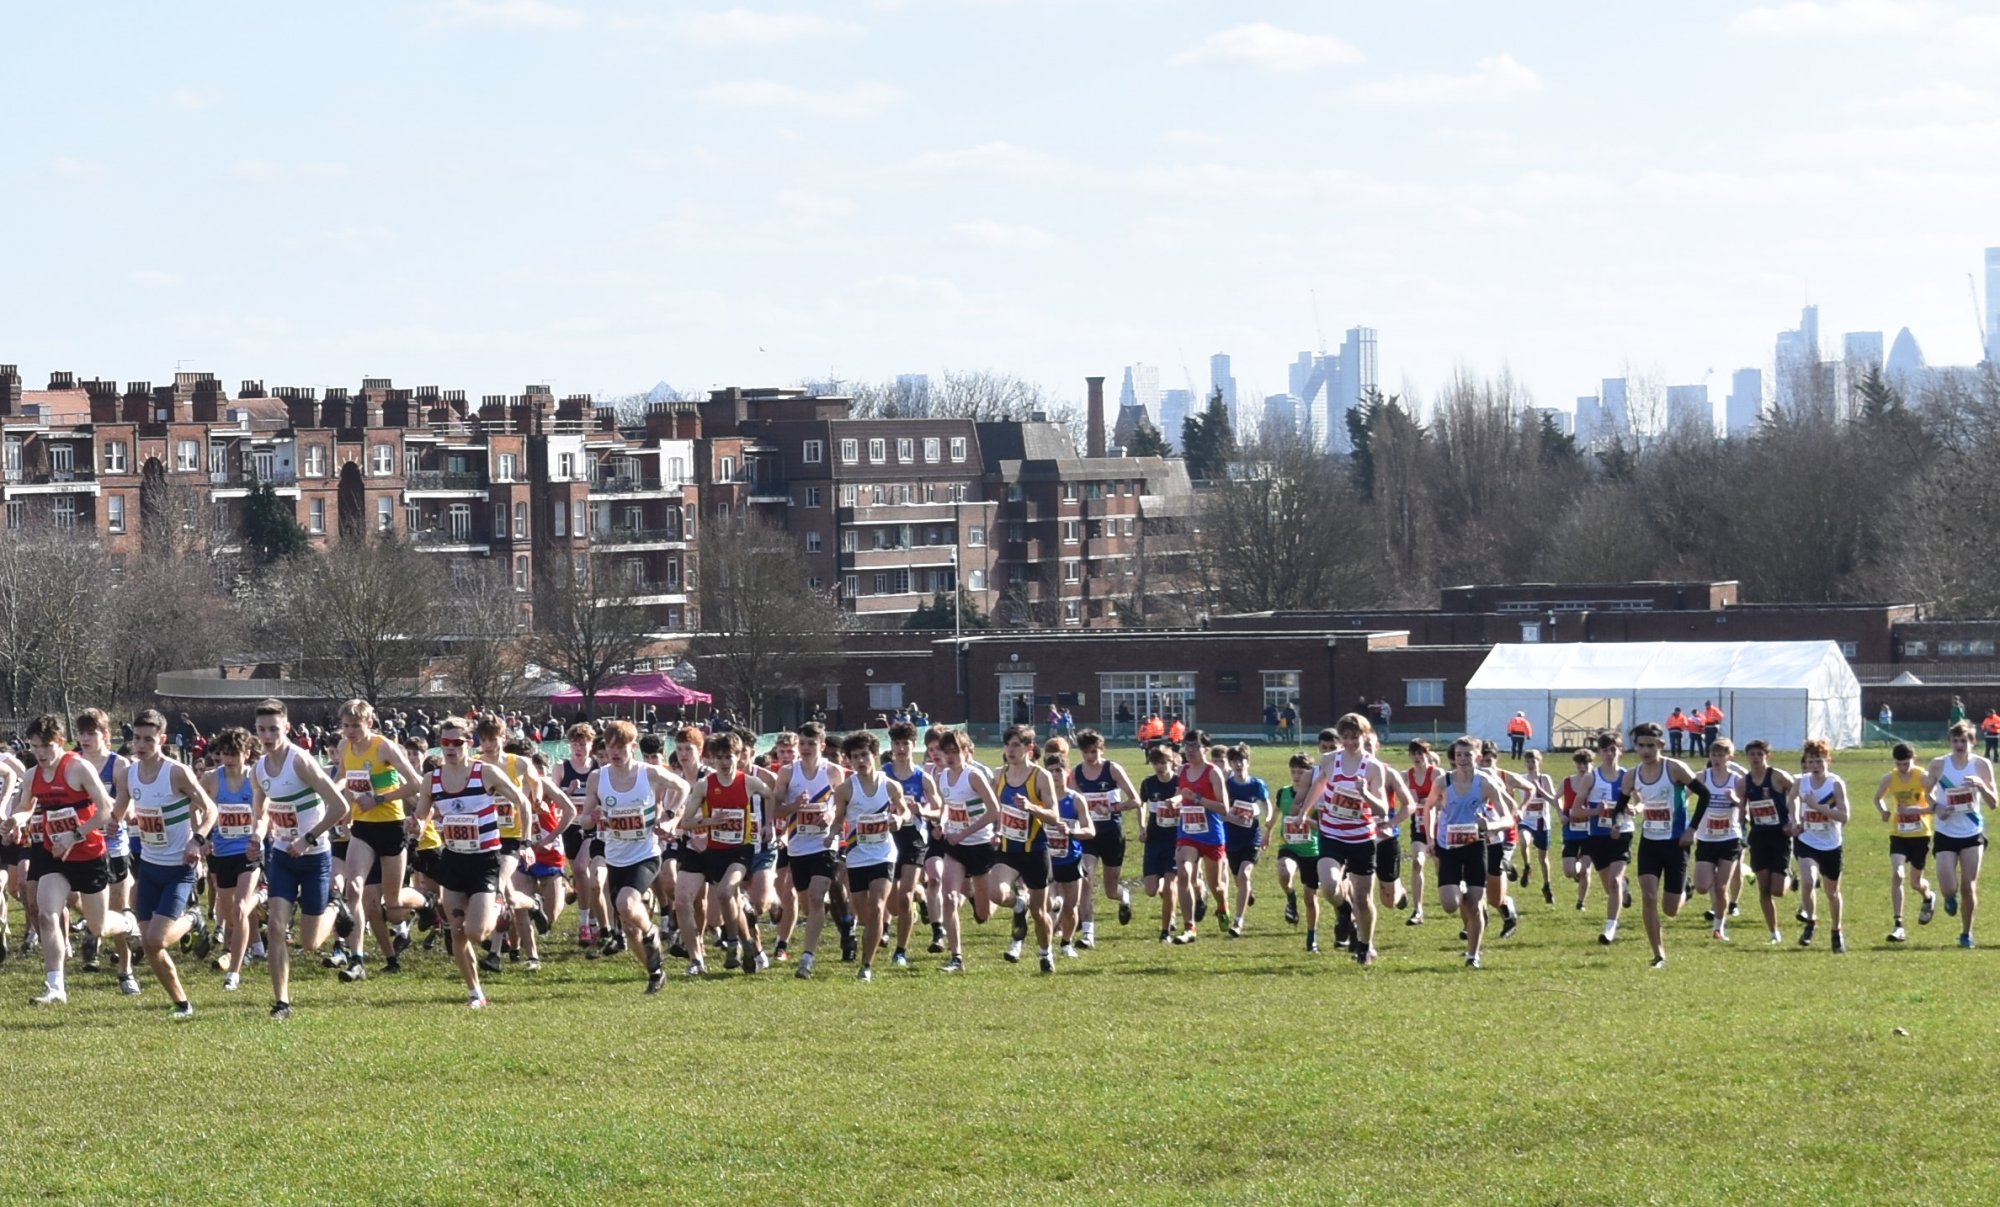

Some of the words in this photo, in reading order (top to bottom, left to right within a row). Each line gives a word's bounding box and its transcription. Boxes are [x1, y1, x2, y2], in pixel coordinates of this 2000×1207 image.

[48, 818, 77, 834] 1819
[140, 815, 163, 833] 016
[221, 812, 250, 826] 2012
[611, 816, 643, 830] 2013
[1003, 812, 1027, 830] 1753
[448, 825, 475, 840] 1881
[861, 821, 887, 834] 1977
